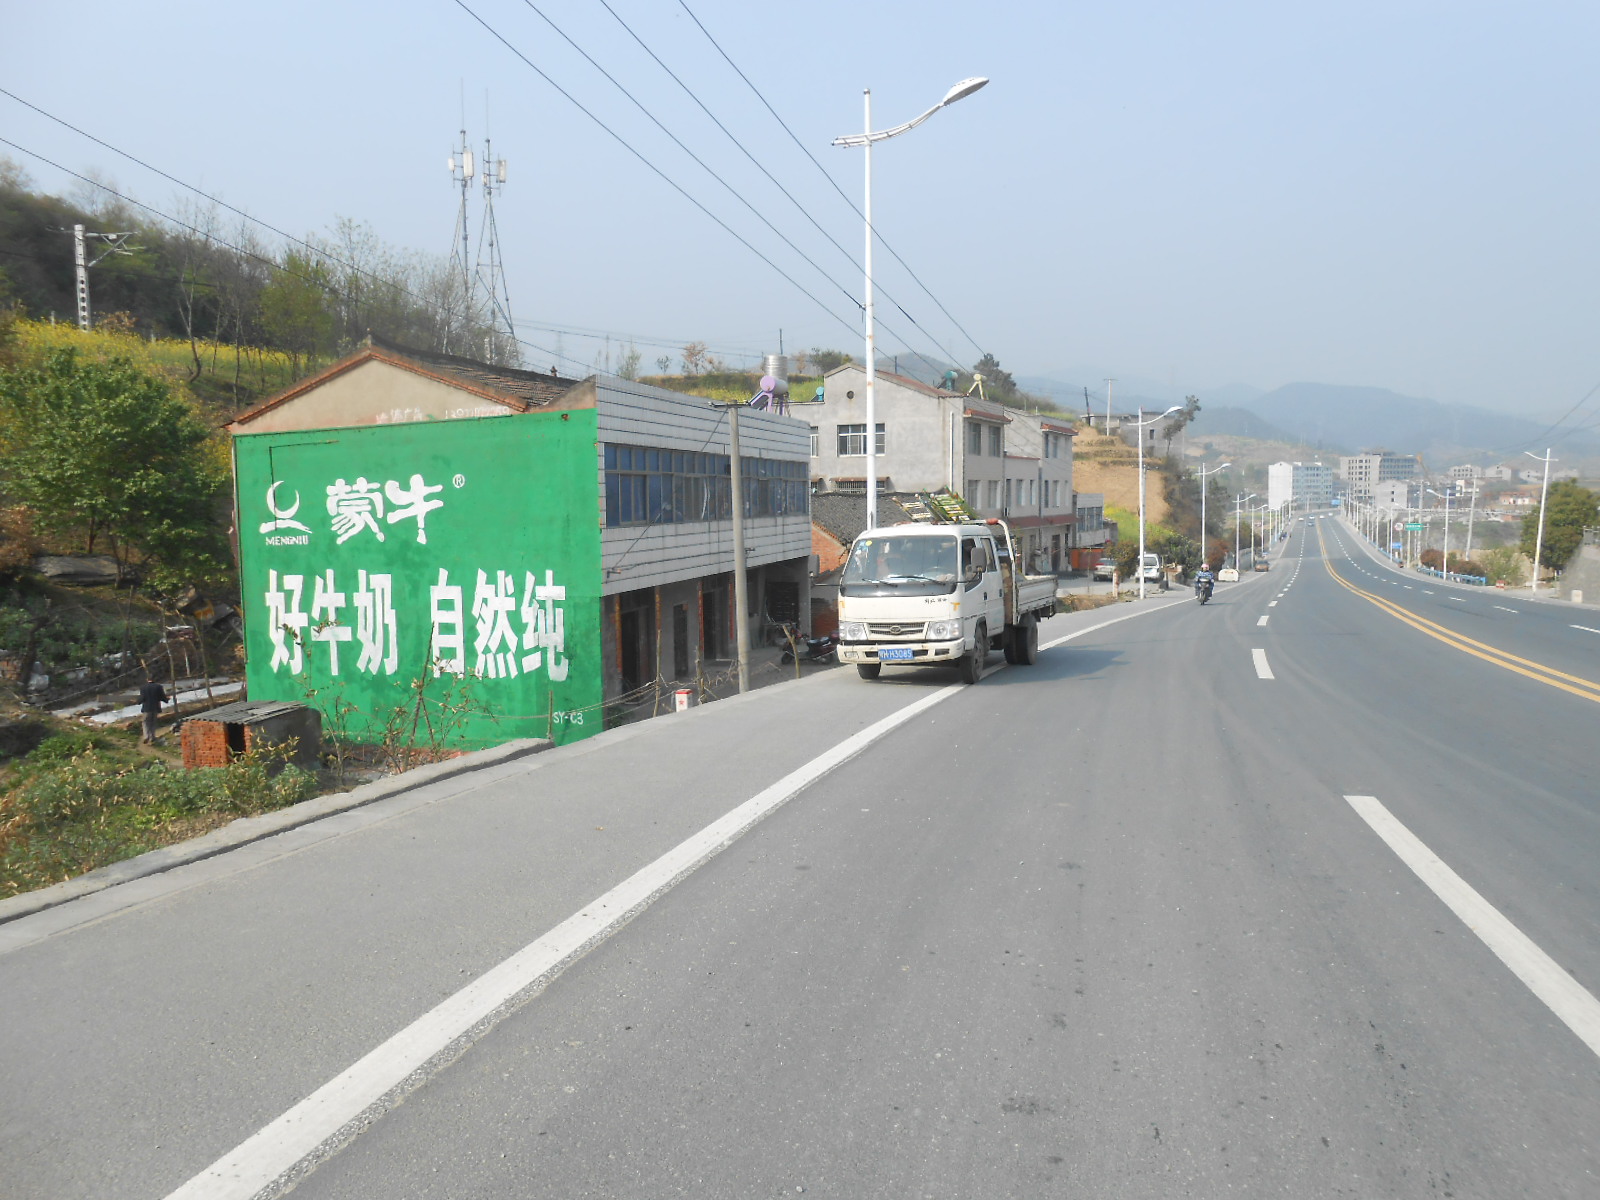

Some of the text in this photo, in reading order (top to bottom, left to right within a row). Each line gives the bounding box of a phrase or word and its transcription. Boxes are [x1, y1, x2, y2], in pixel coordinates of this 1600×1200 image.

[326, 473, 443, 545] 蒙牛
[265, 535, 309, 546] MENGNIU
[264, 568, 398, 676] 好牛奶
[429, 567, 569, 682] 自然纯
[553, 711, 584, 725] SY-C3
